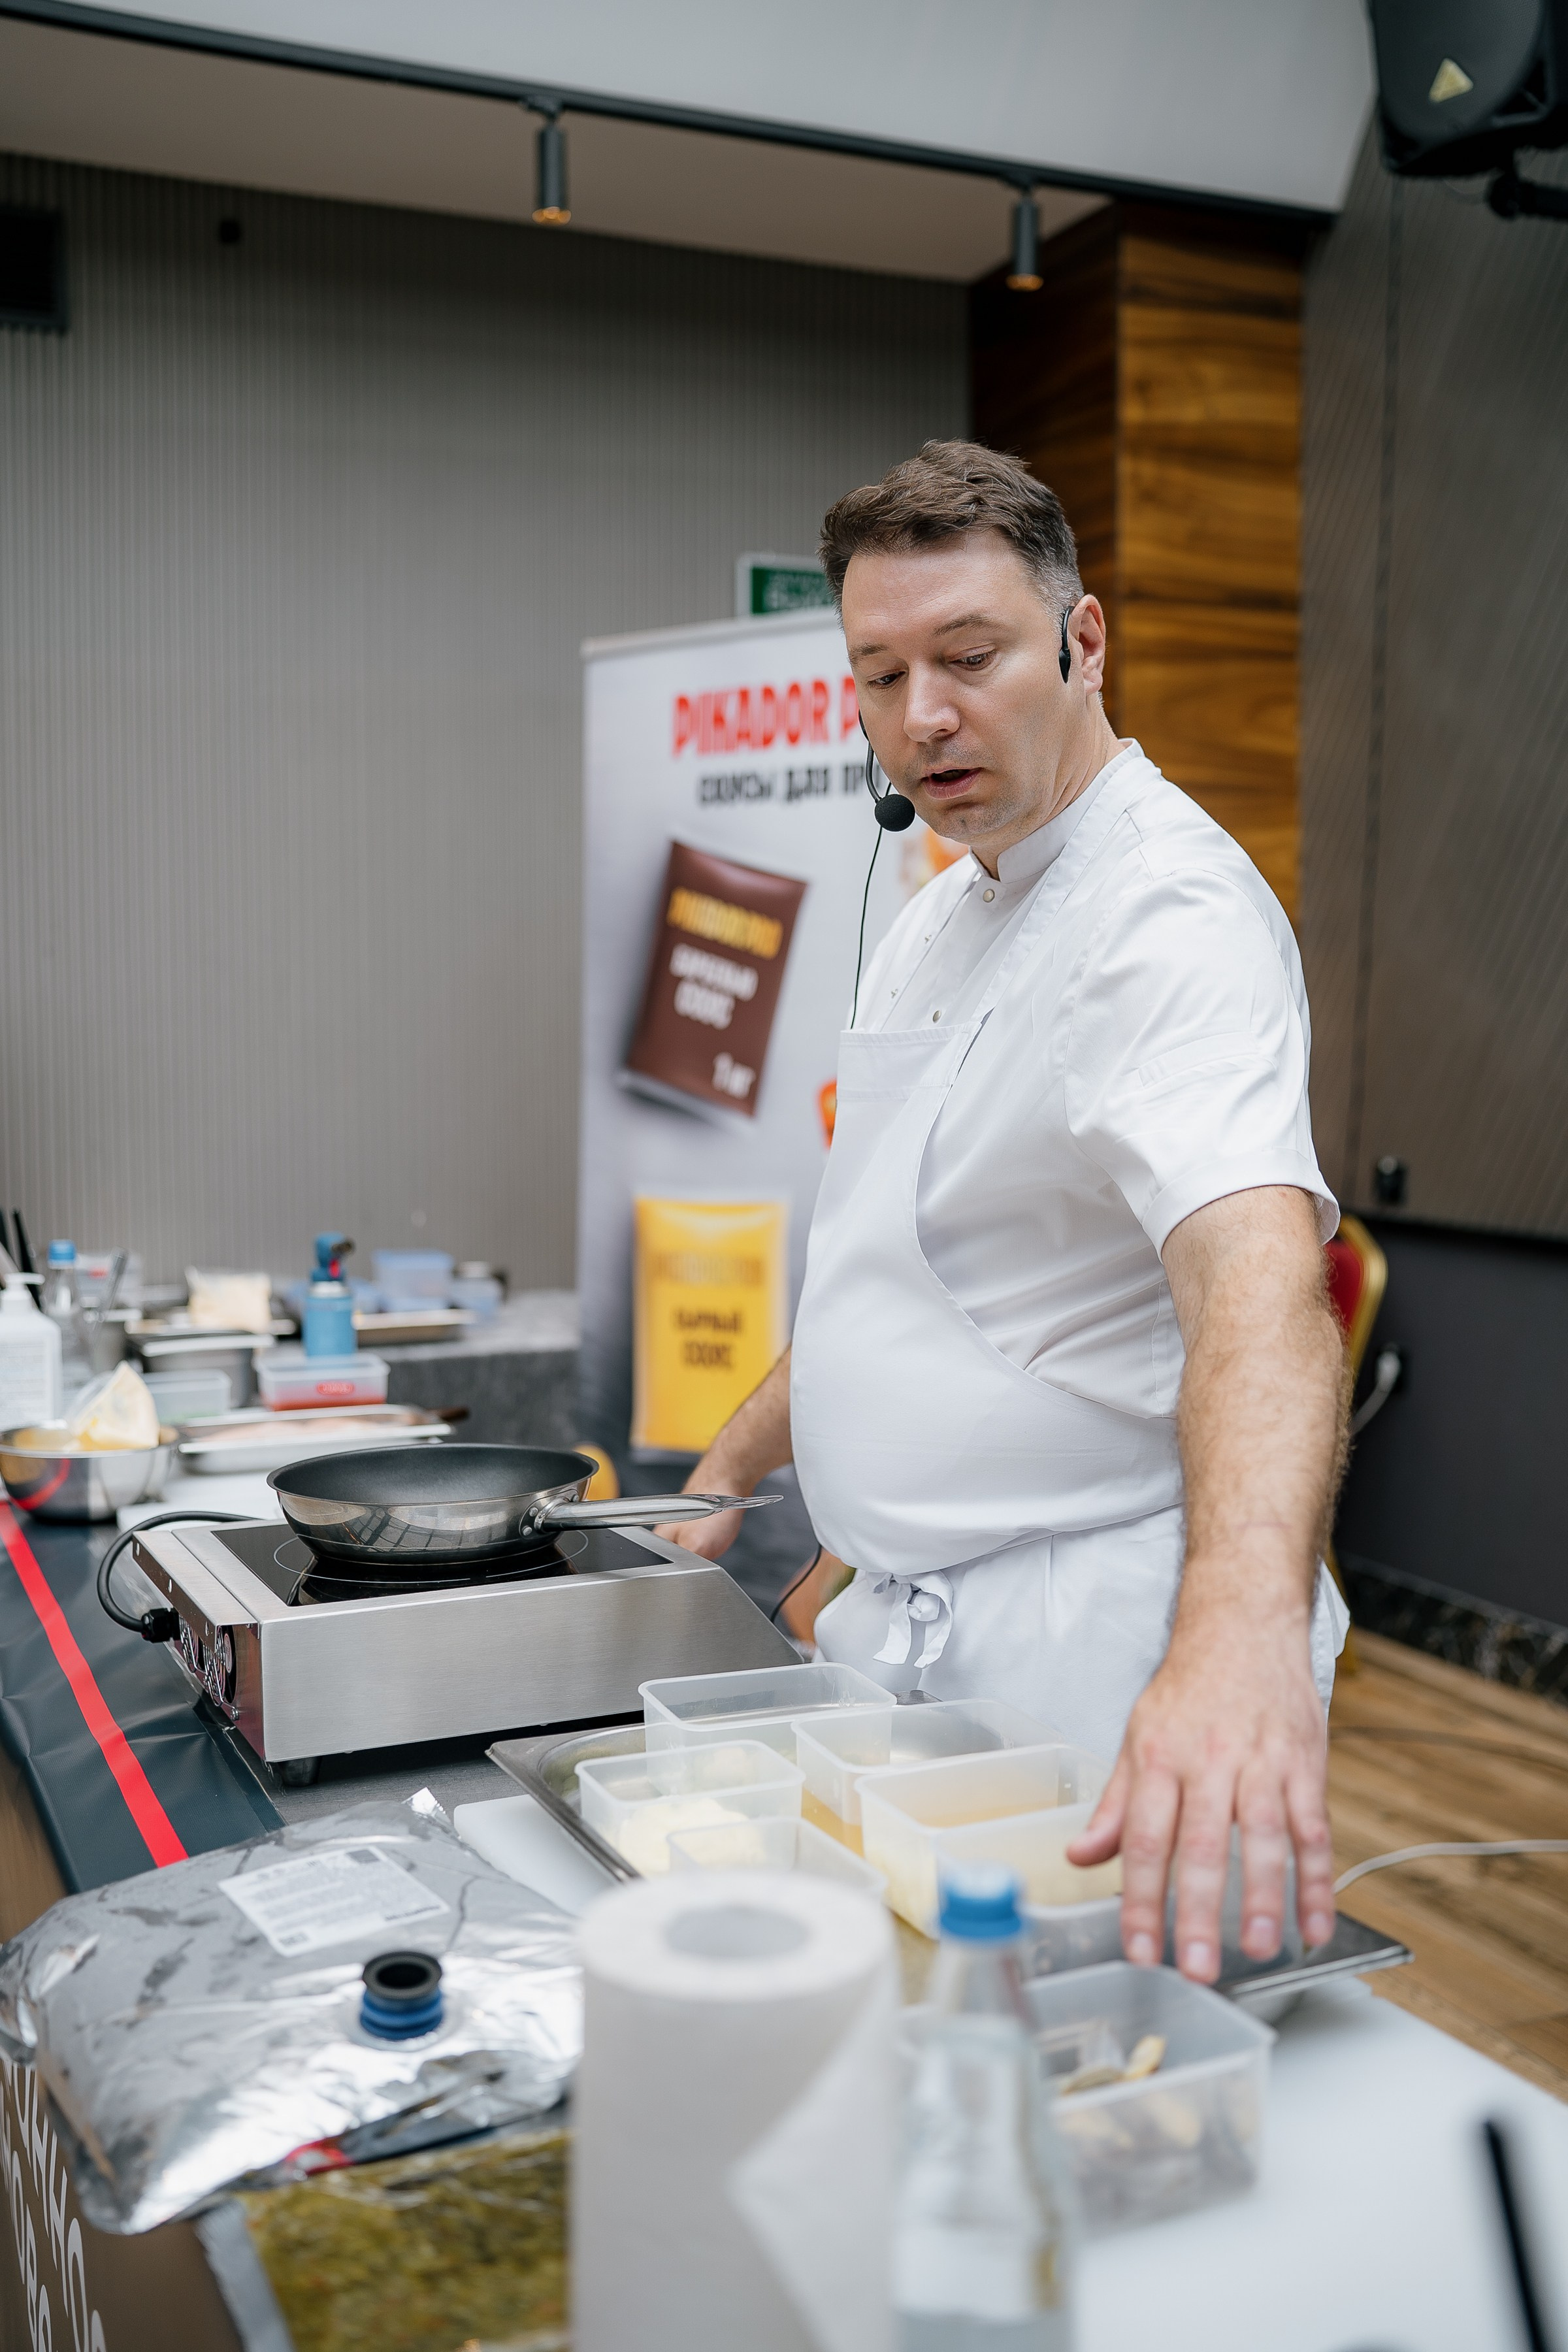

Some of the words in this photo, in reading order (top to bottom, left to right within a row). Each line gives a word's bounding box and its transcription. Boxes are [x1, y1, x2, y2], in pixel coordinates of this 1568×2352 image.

[674, 678, 830, 758] PIKADOR
[840, 674, 859, 739] P
[843, 762, 883, 794] ПР
